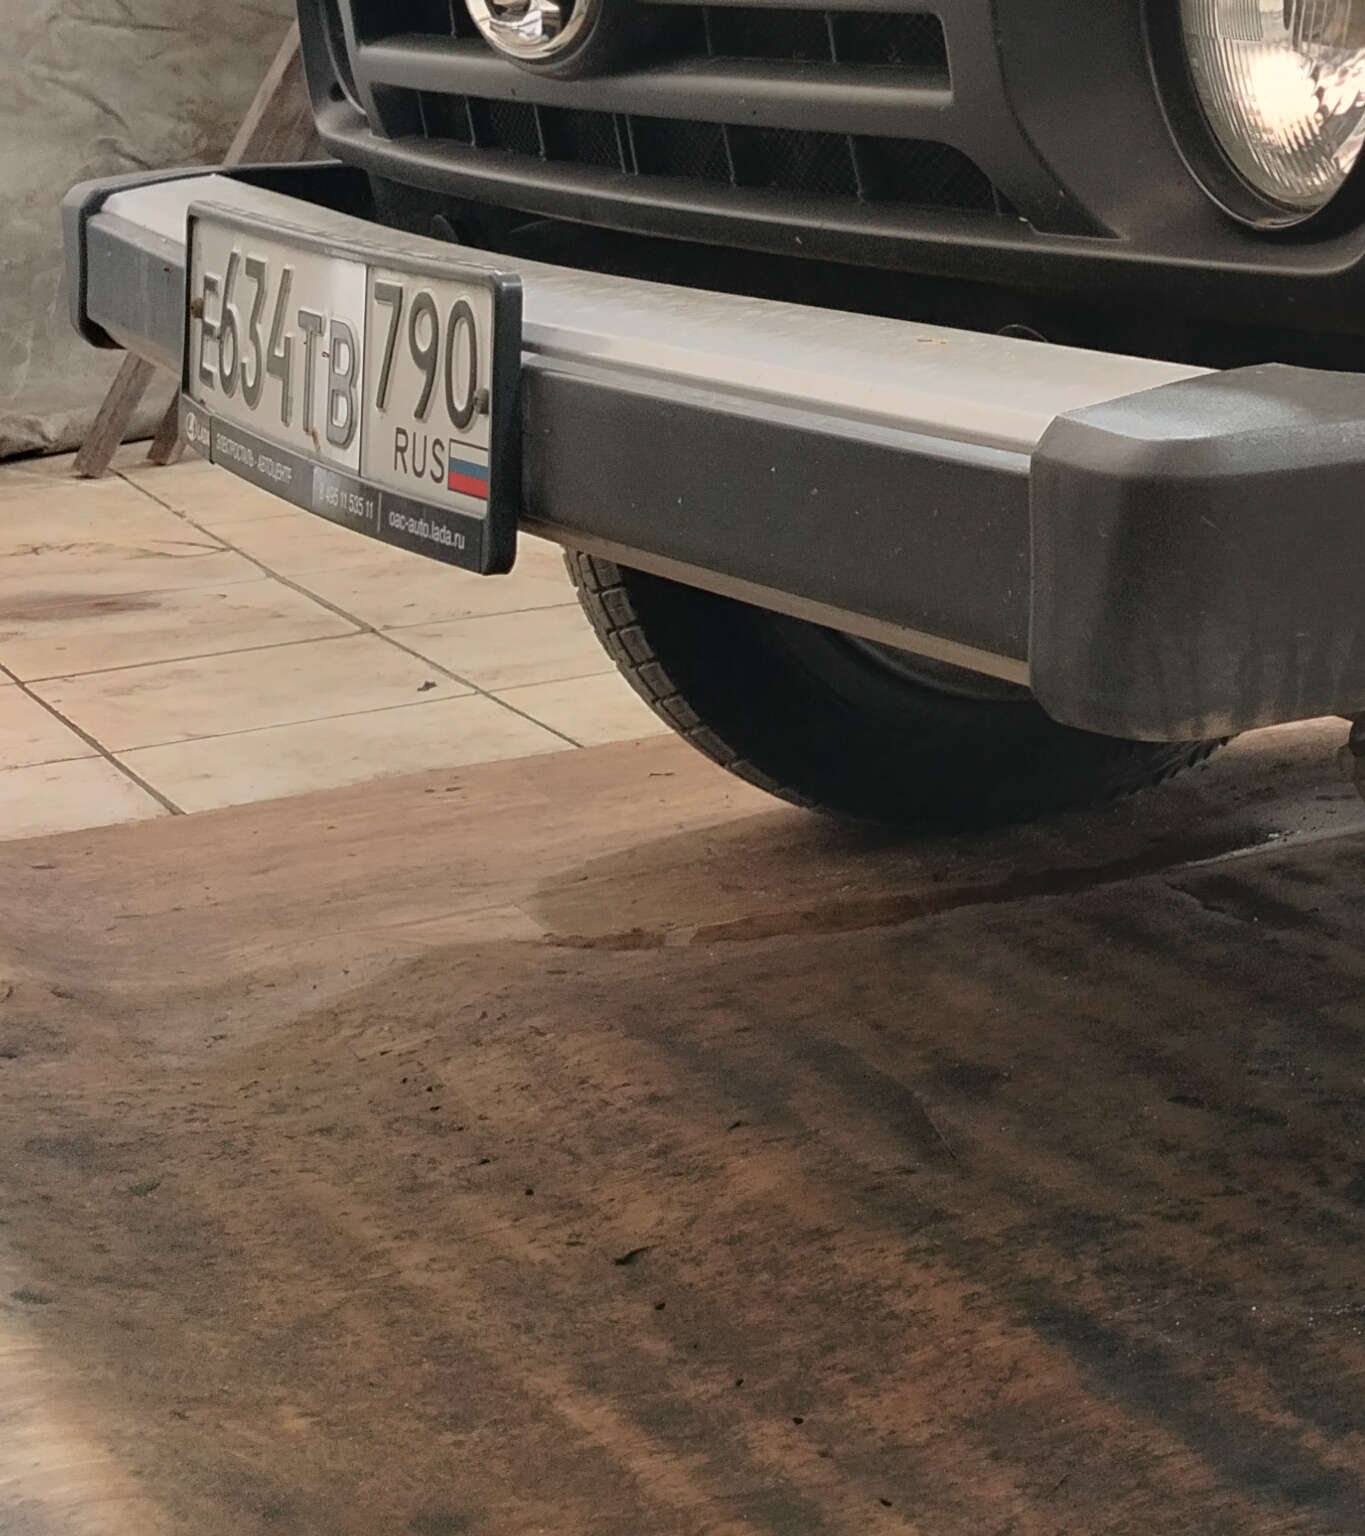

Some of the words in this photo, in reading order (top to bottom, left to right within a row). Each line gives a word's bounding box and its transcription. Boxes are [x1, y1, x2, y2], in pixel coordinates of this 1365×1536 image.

[374, 278, 479, 431] 790
[393, 426, 446, 484] RUS
[325, 485, 339, 506] 495
[340, 490, 348, 510] 11
[349, 495, 364, 515] 535
[365, 500, 374, 520] 11
[388, 511, 465, 549] oac-auto.lada.ru
